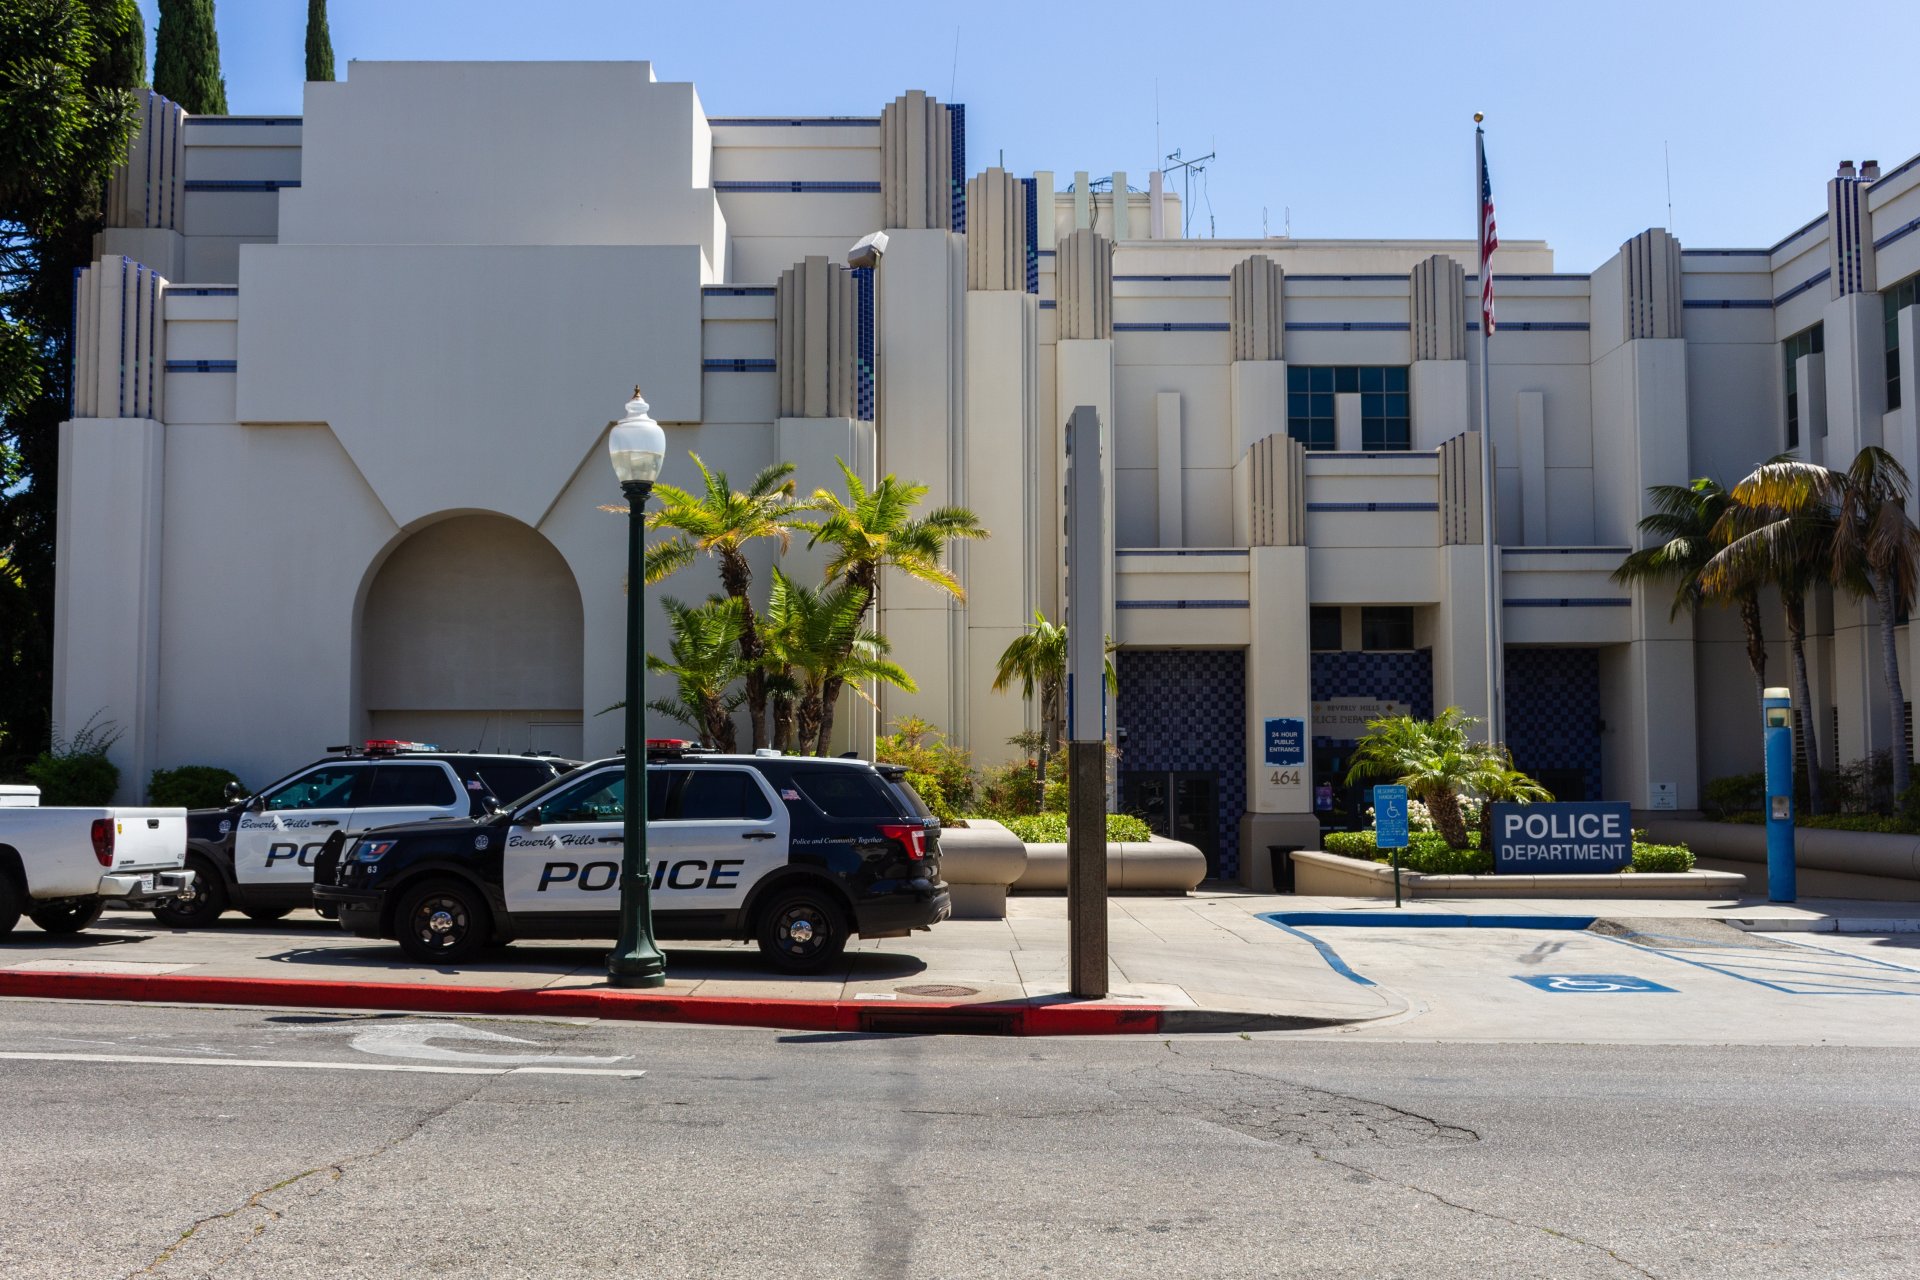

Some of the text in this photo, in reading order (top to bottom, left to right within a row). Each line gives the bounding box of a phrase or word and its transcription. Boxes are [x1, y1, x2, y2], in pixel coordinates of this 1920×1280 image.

[1327, 704, 1380, 712] BEVERLY HILLS
[1270, 770, 1301, 785] 464
[241, 818, 279, 830] Beverly
[282, 818, 310, 828] Hills
[1504, 813, 1621, 839] POLICE
[508, 834, 596, 849] Beverly Hills
[824, 837, 857, 845] Community
[858, 836, 882, 845] Together
[1501, 844, 1626, 860] DEPARTMENT
[367, 865, 378, 874] 63
[537, 859, 745, 892] POICE
